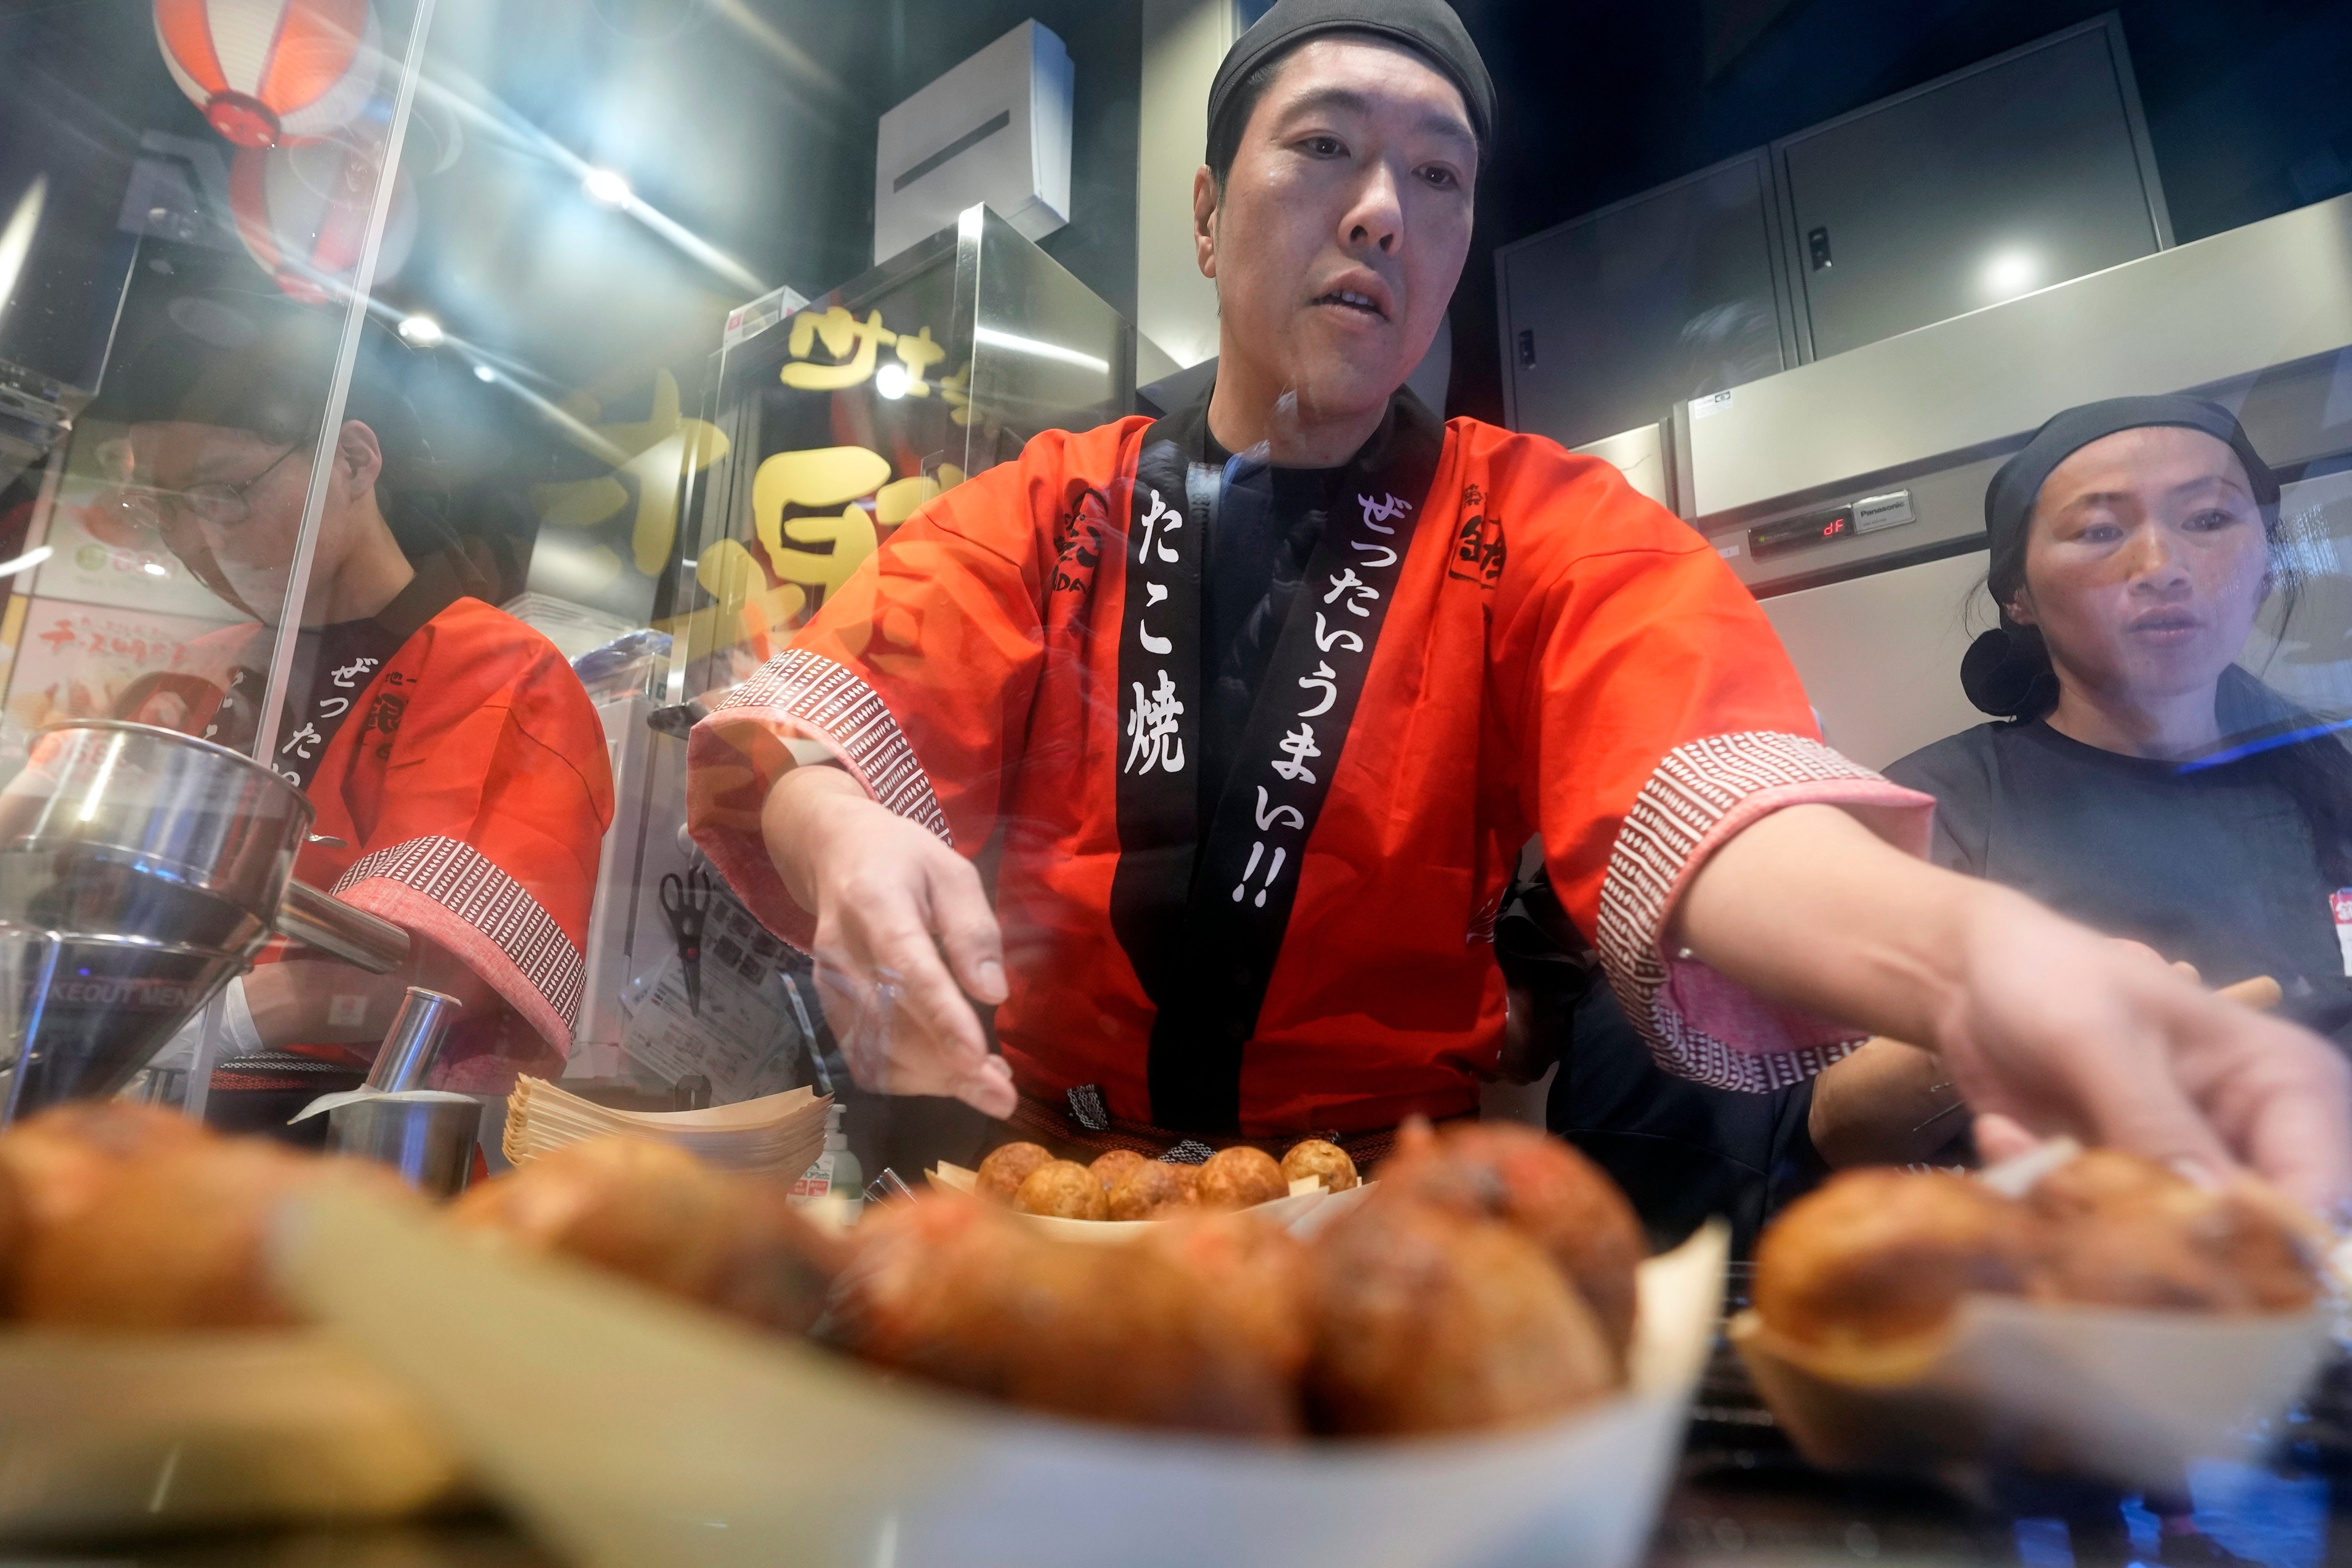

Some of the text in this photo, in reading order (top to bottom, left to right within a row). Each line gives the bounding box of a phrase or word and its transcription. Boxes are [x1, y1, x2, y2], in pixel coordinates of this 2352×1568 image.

[1861, 502, 1905, 517] Panasonic
[1124, 490, 1185, 775] たこ焼
